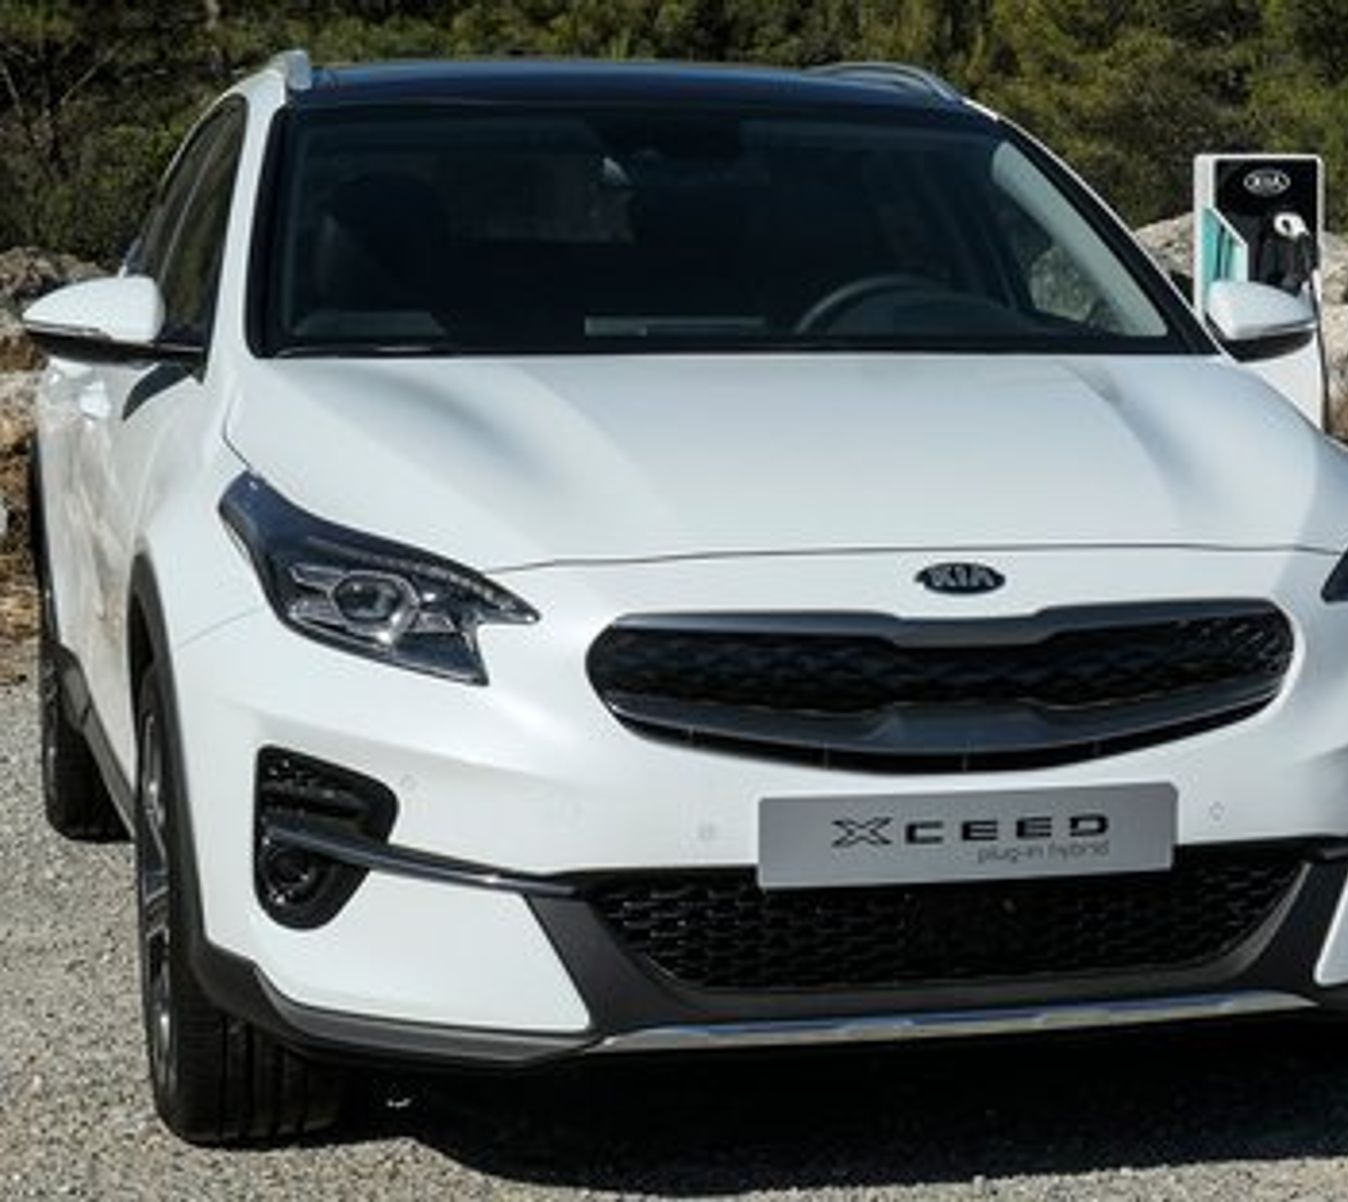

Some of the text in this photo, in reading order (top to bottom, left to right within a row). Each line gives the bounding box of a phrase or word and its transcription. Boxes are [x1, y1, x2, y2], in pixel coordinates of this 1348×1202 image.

[831, 814, 1110, 848] XCEED
[978, 838, 1110, 864] plug-in hybrid
